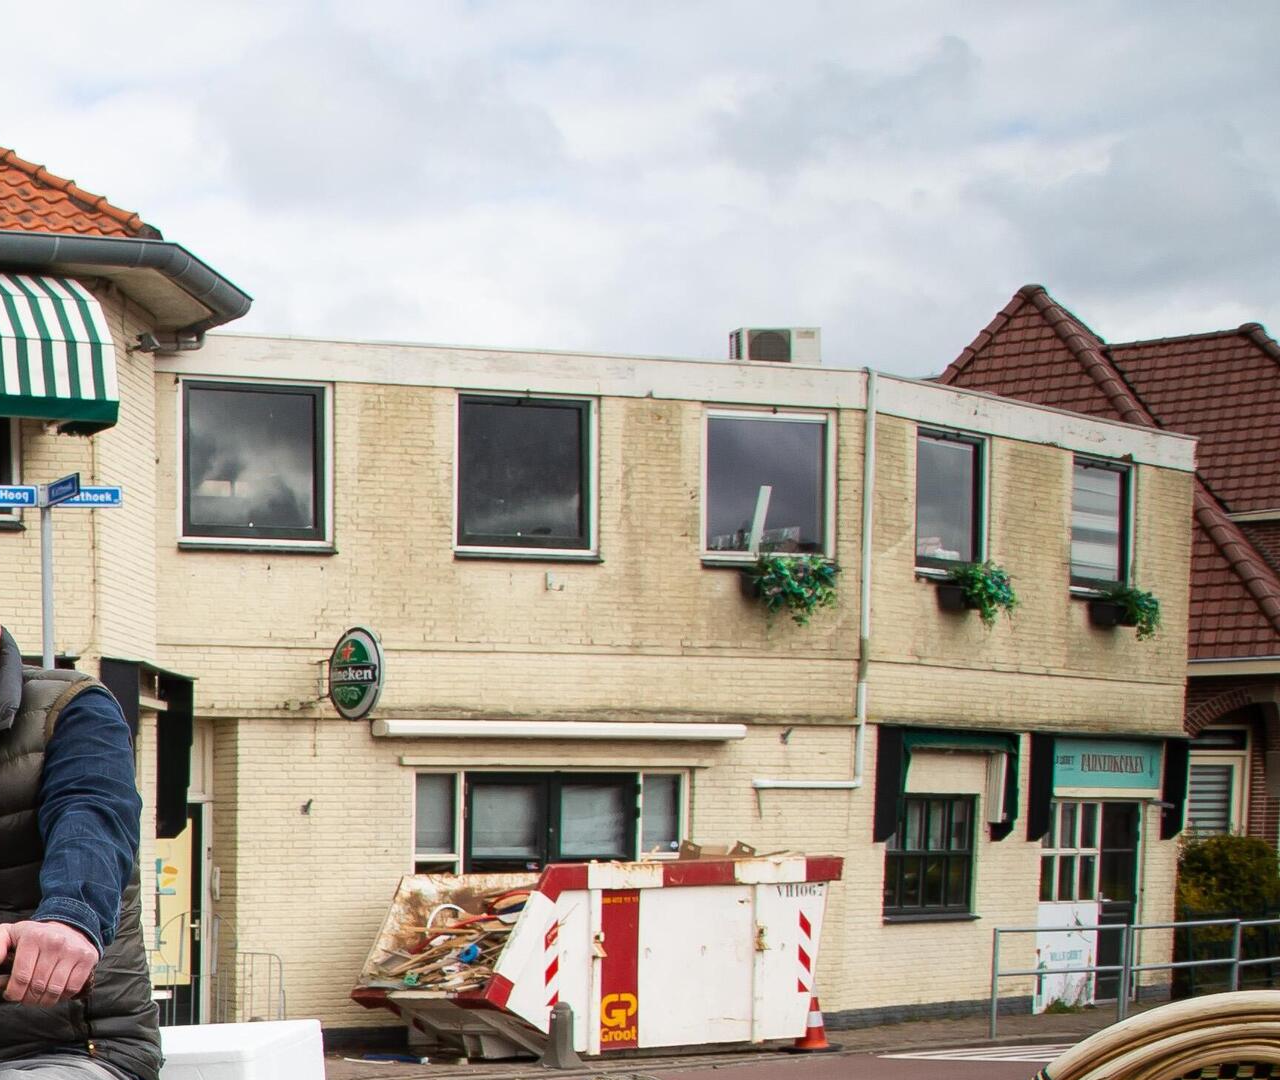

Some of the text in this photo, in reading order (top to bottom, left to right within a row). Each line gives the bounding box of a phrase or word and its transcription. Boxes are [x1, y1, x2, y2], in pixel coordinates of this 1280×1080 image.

[0, 489, 29, 502] Hoog
[70, 491, 112, 502] athoek
[600, 1025, 637, 1042] Groot
